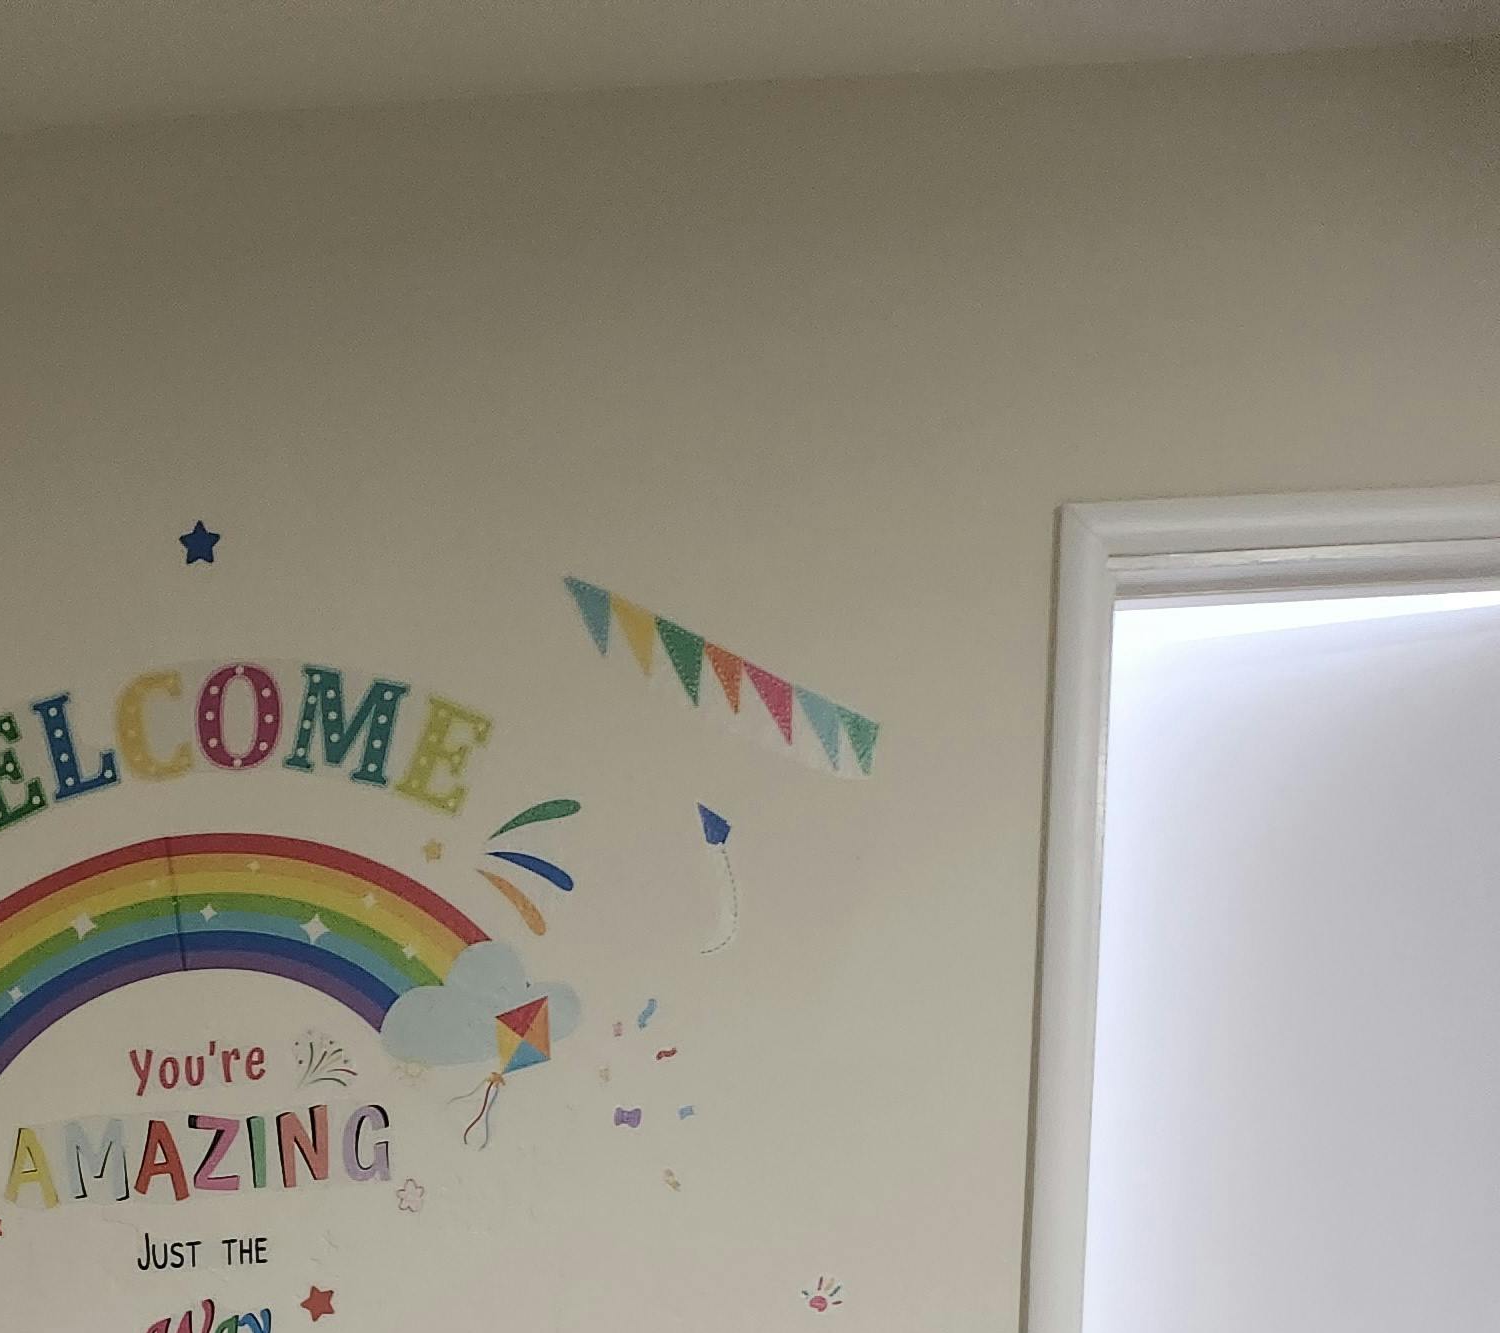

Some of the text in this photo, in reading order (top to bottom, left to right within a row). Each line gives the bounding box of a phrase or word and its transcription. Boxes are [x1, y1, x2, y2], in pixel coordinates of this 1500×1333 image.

[4, 1104, 392, 1207] AMAZING
[137, 1233, 268, 1271] JUST THE
